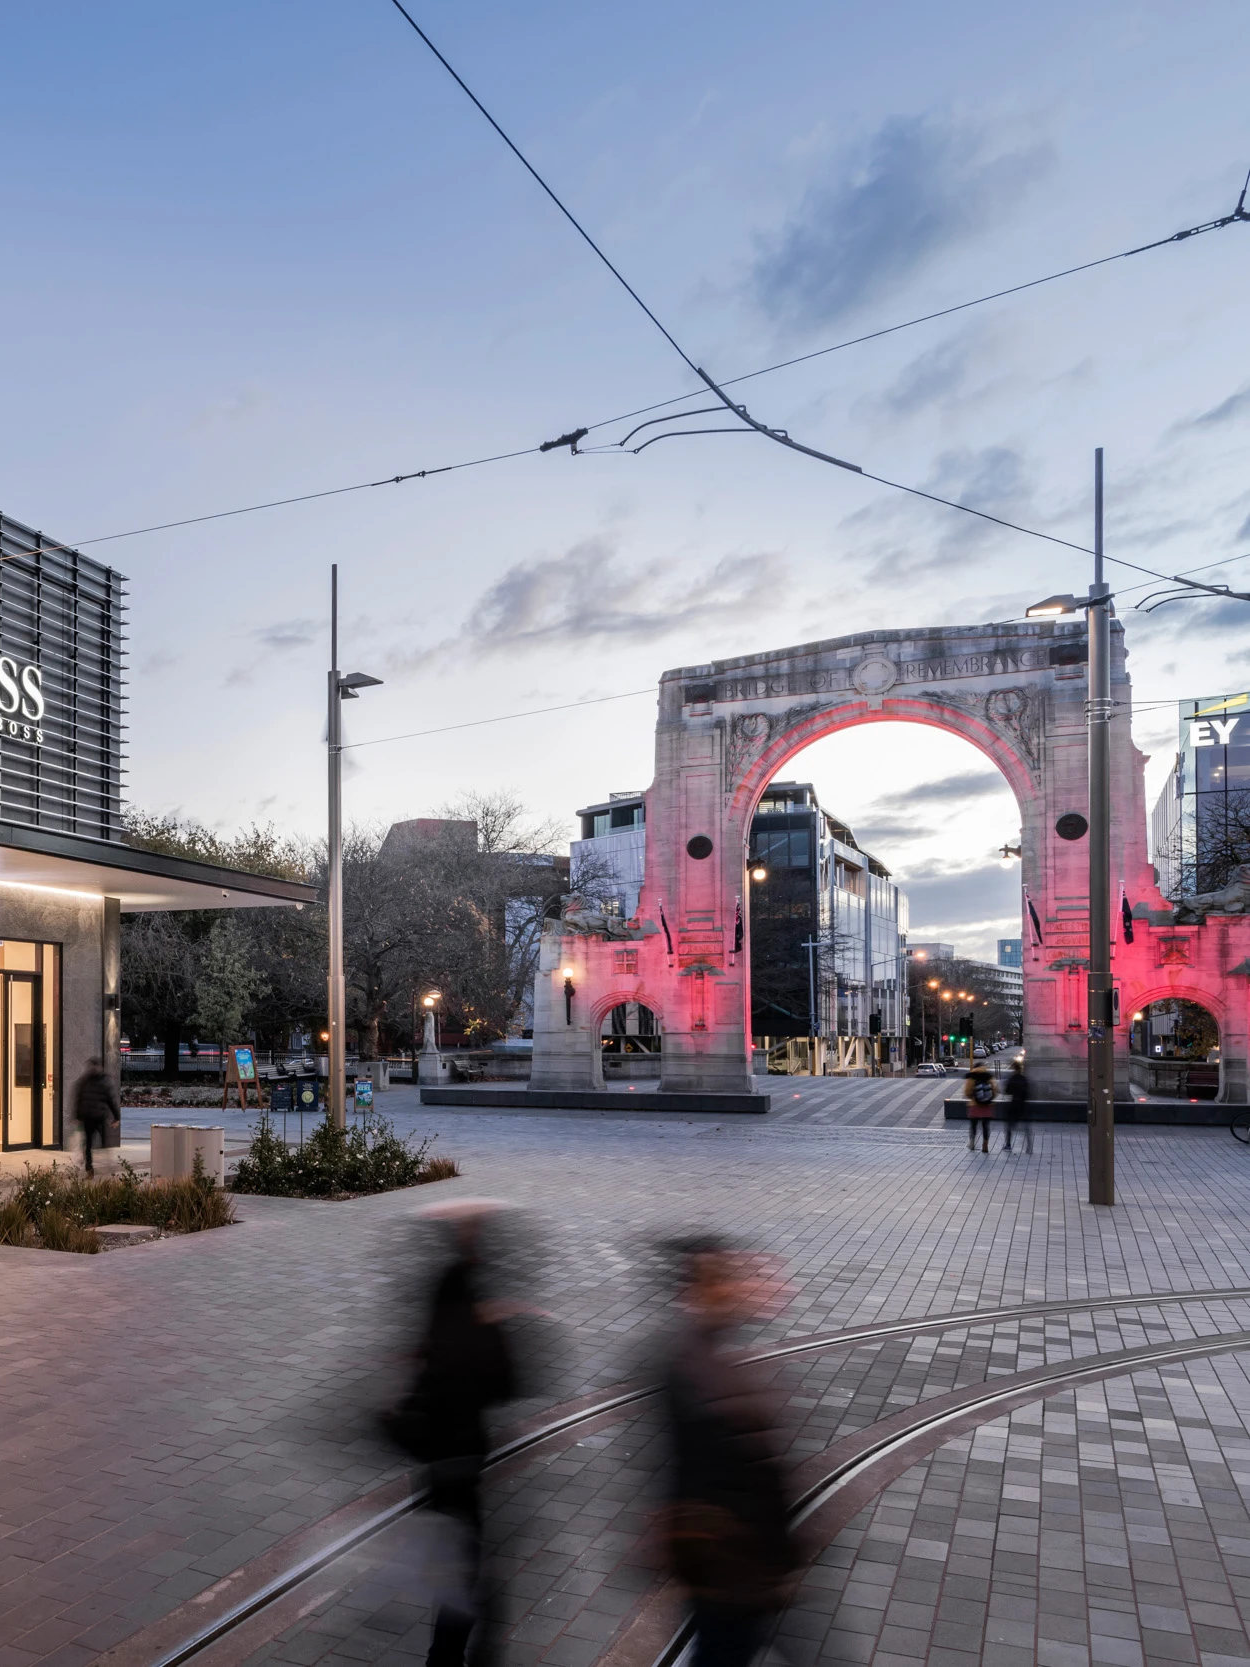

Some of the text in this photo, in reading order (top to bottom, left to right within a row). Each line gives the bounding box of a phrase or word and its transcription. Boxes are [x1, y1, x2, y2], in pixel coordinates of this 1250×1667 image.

[724, 650, 1047, 698] BRIDGE OF REMEMBRANCE
[1190, 718, 1240, 747] EY
